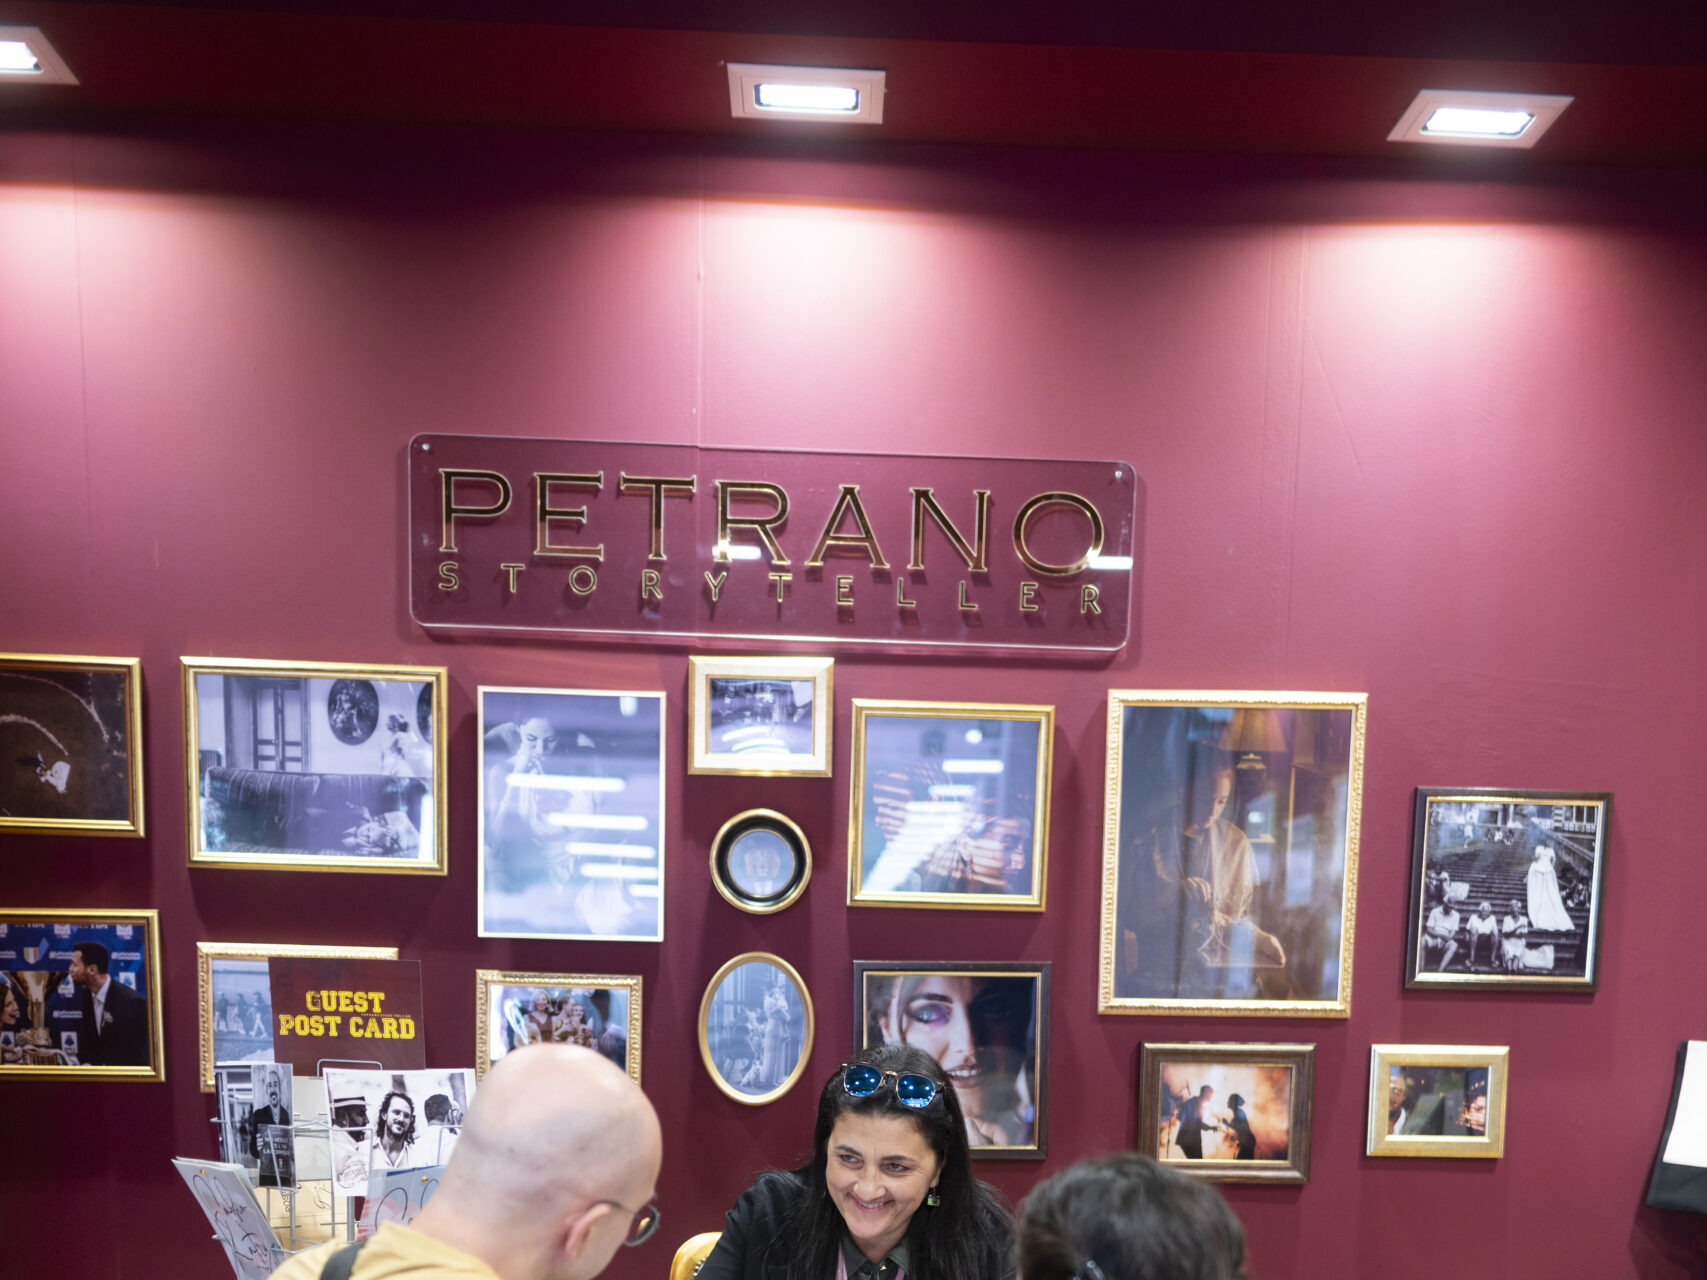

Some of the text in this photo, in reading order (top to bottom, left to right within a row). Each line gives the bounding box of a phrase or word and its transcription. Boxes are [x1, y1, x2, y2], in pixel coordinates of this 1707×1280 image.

[437, 467, 1106, 577] PETRANO
[437, 560, 1102, 615] STORYTELLER
[305, 990, 386, 1013] GUEST
[278, 1014, 416, 1040] POST CARD
